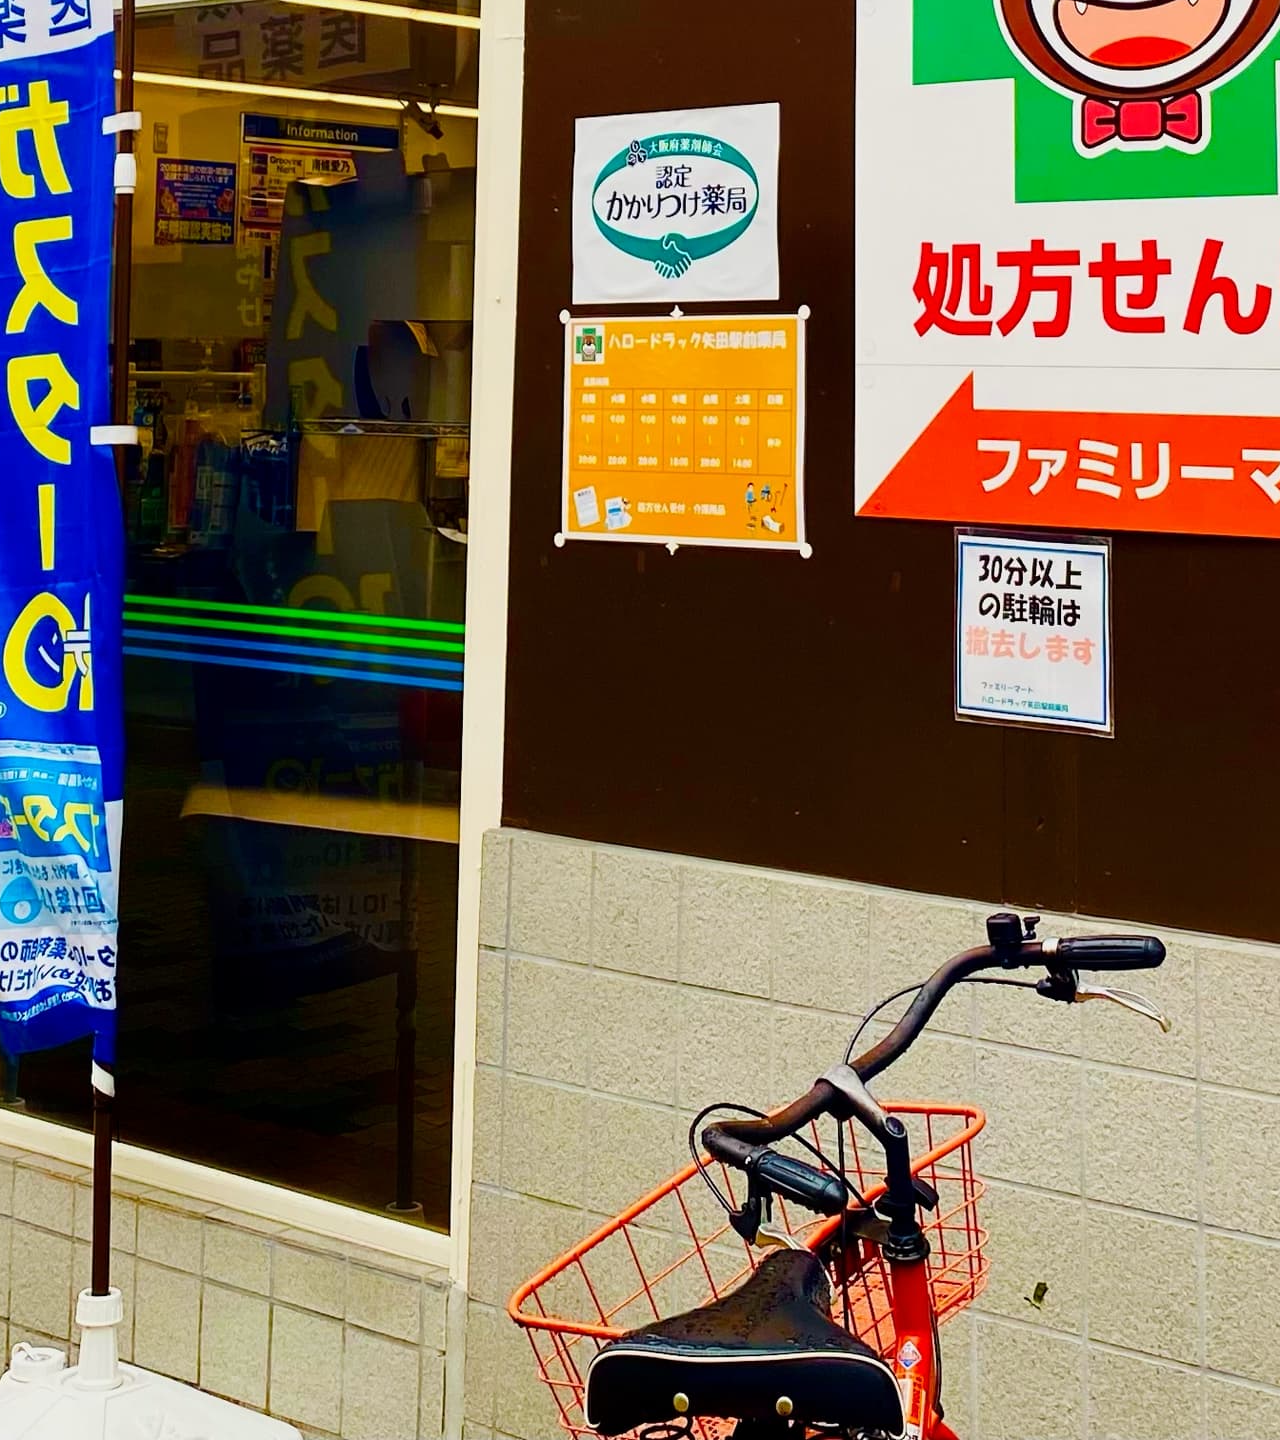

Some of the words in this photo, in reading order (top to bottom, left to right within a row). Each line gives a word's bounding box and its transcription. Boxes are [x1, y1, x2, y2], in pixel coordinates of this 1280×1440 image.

[287, 123, 358, 142] Information
[649, 137, 724, 157] 大阪府薬剤師会
[656, 164, 692, 189] 認定
[606, 184, 747, 221] かかりつけ薬局
[978, 554, 1082, 590] 30分以上
[978, 592, 1081, 627] の駐輪は
[965, 625, 1097, 665] 撤去します
